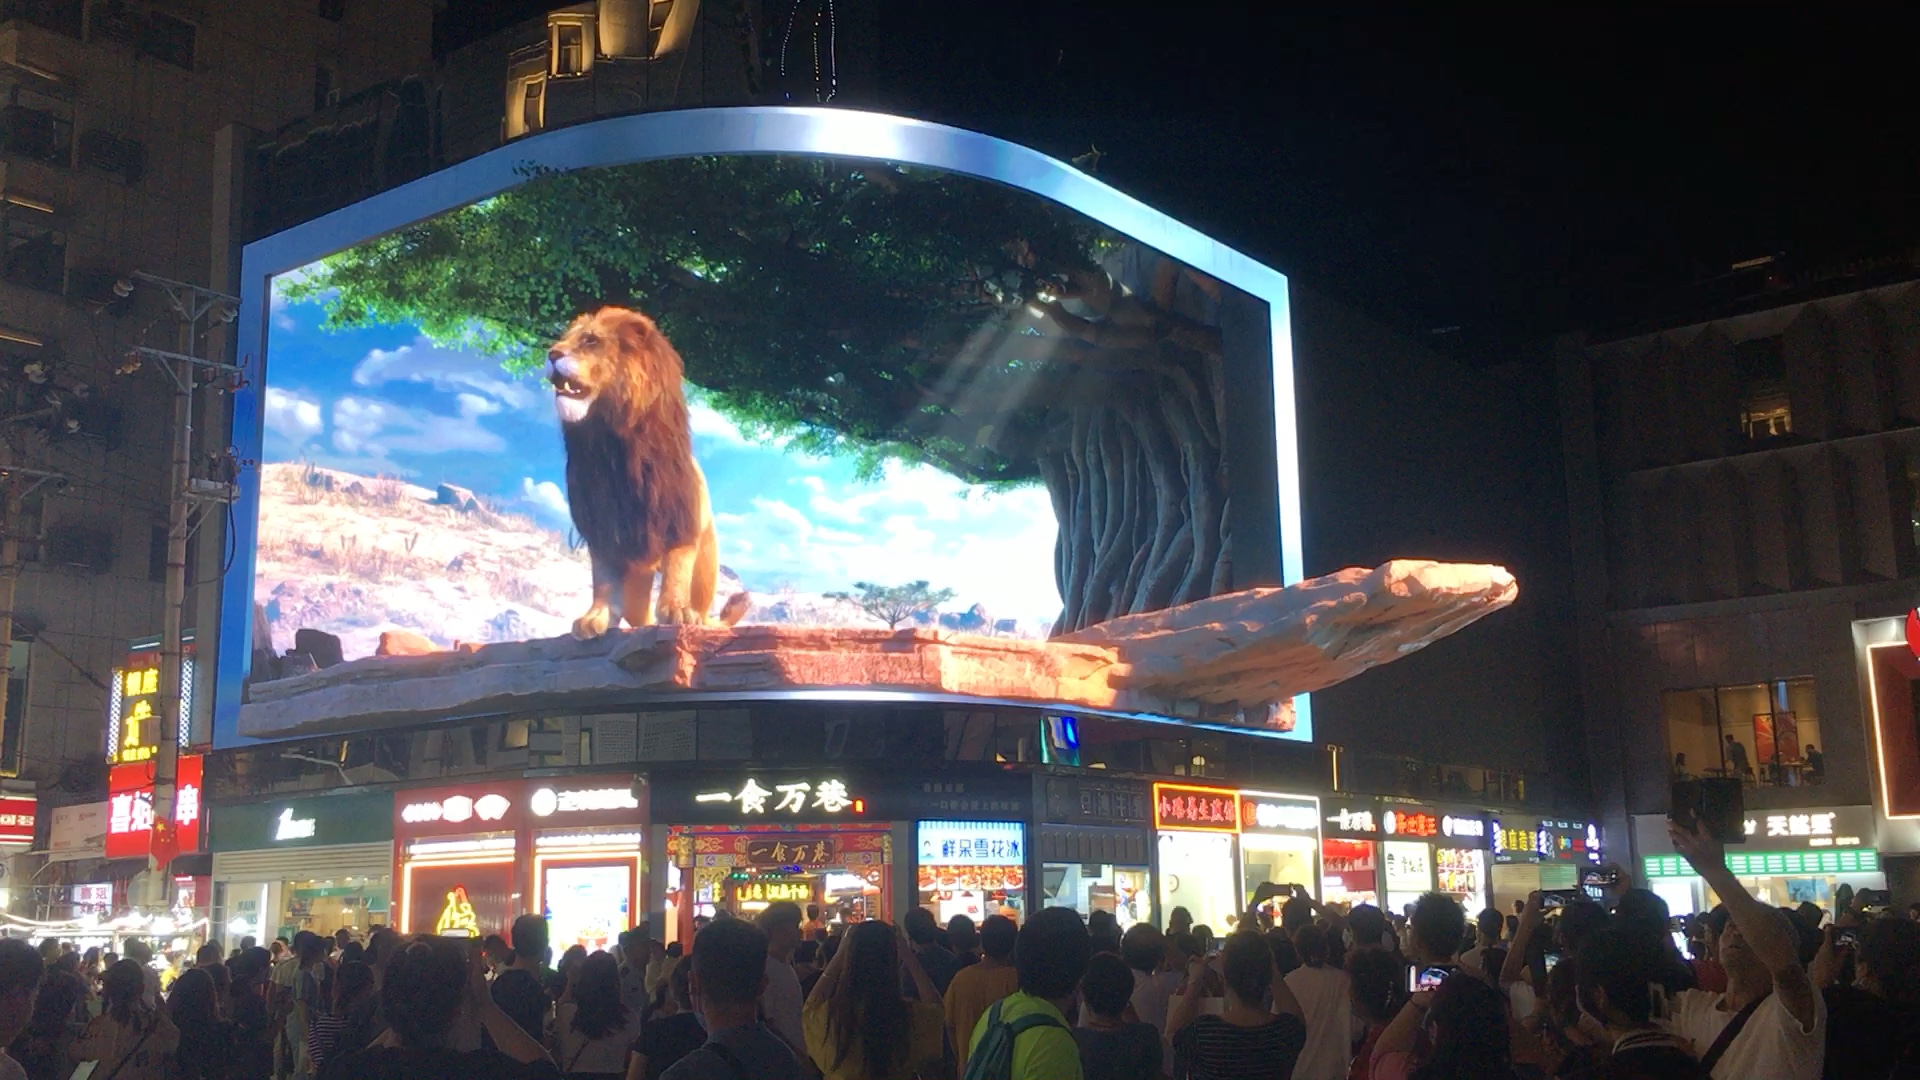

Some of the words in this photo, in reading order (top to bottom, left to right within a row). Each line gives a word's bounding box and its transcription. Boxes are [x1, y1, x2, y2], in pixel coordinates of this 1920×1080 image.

[111, 784, 199, 833] 喜姐串
[696, 778, 853, 813] 一食万巷
[752, 840, 829, 863] 一食万巷
